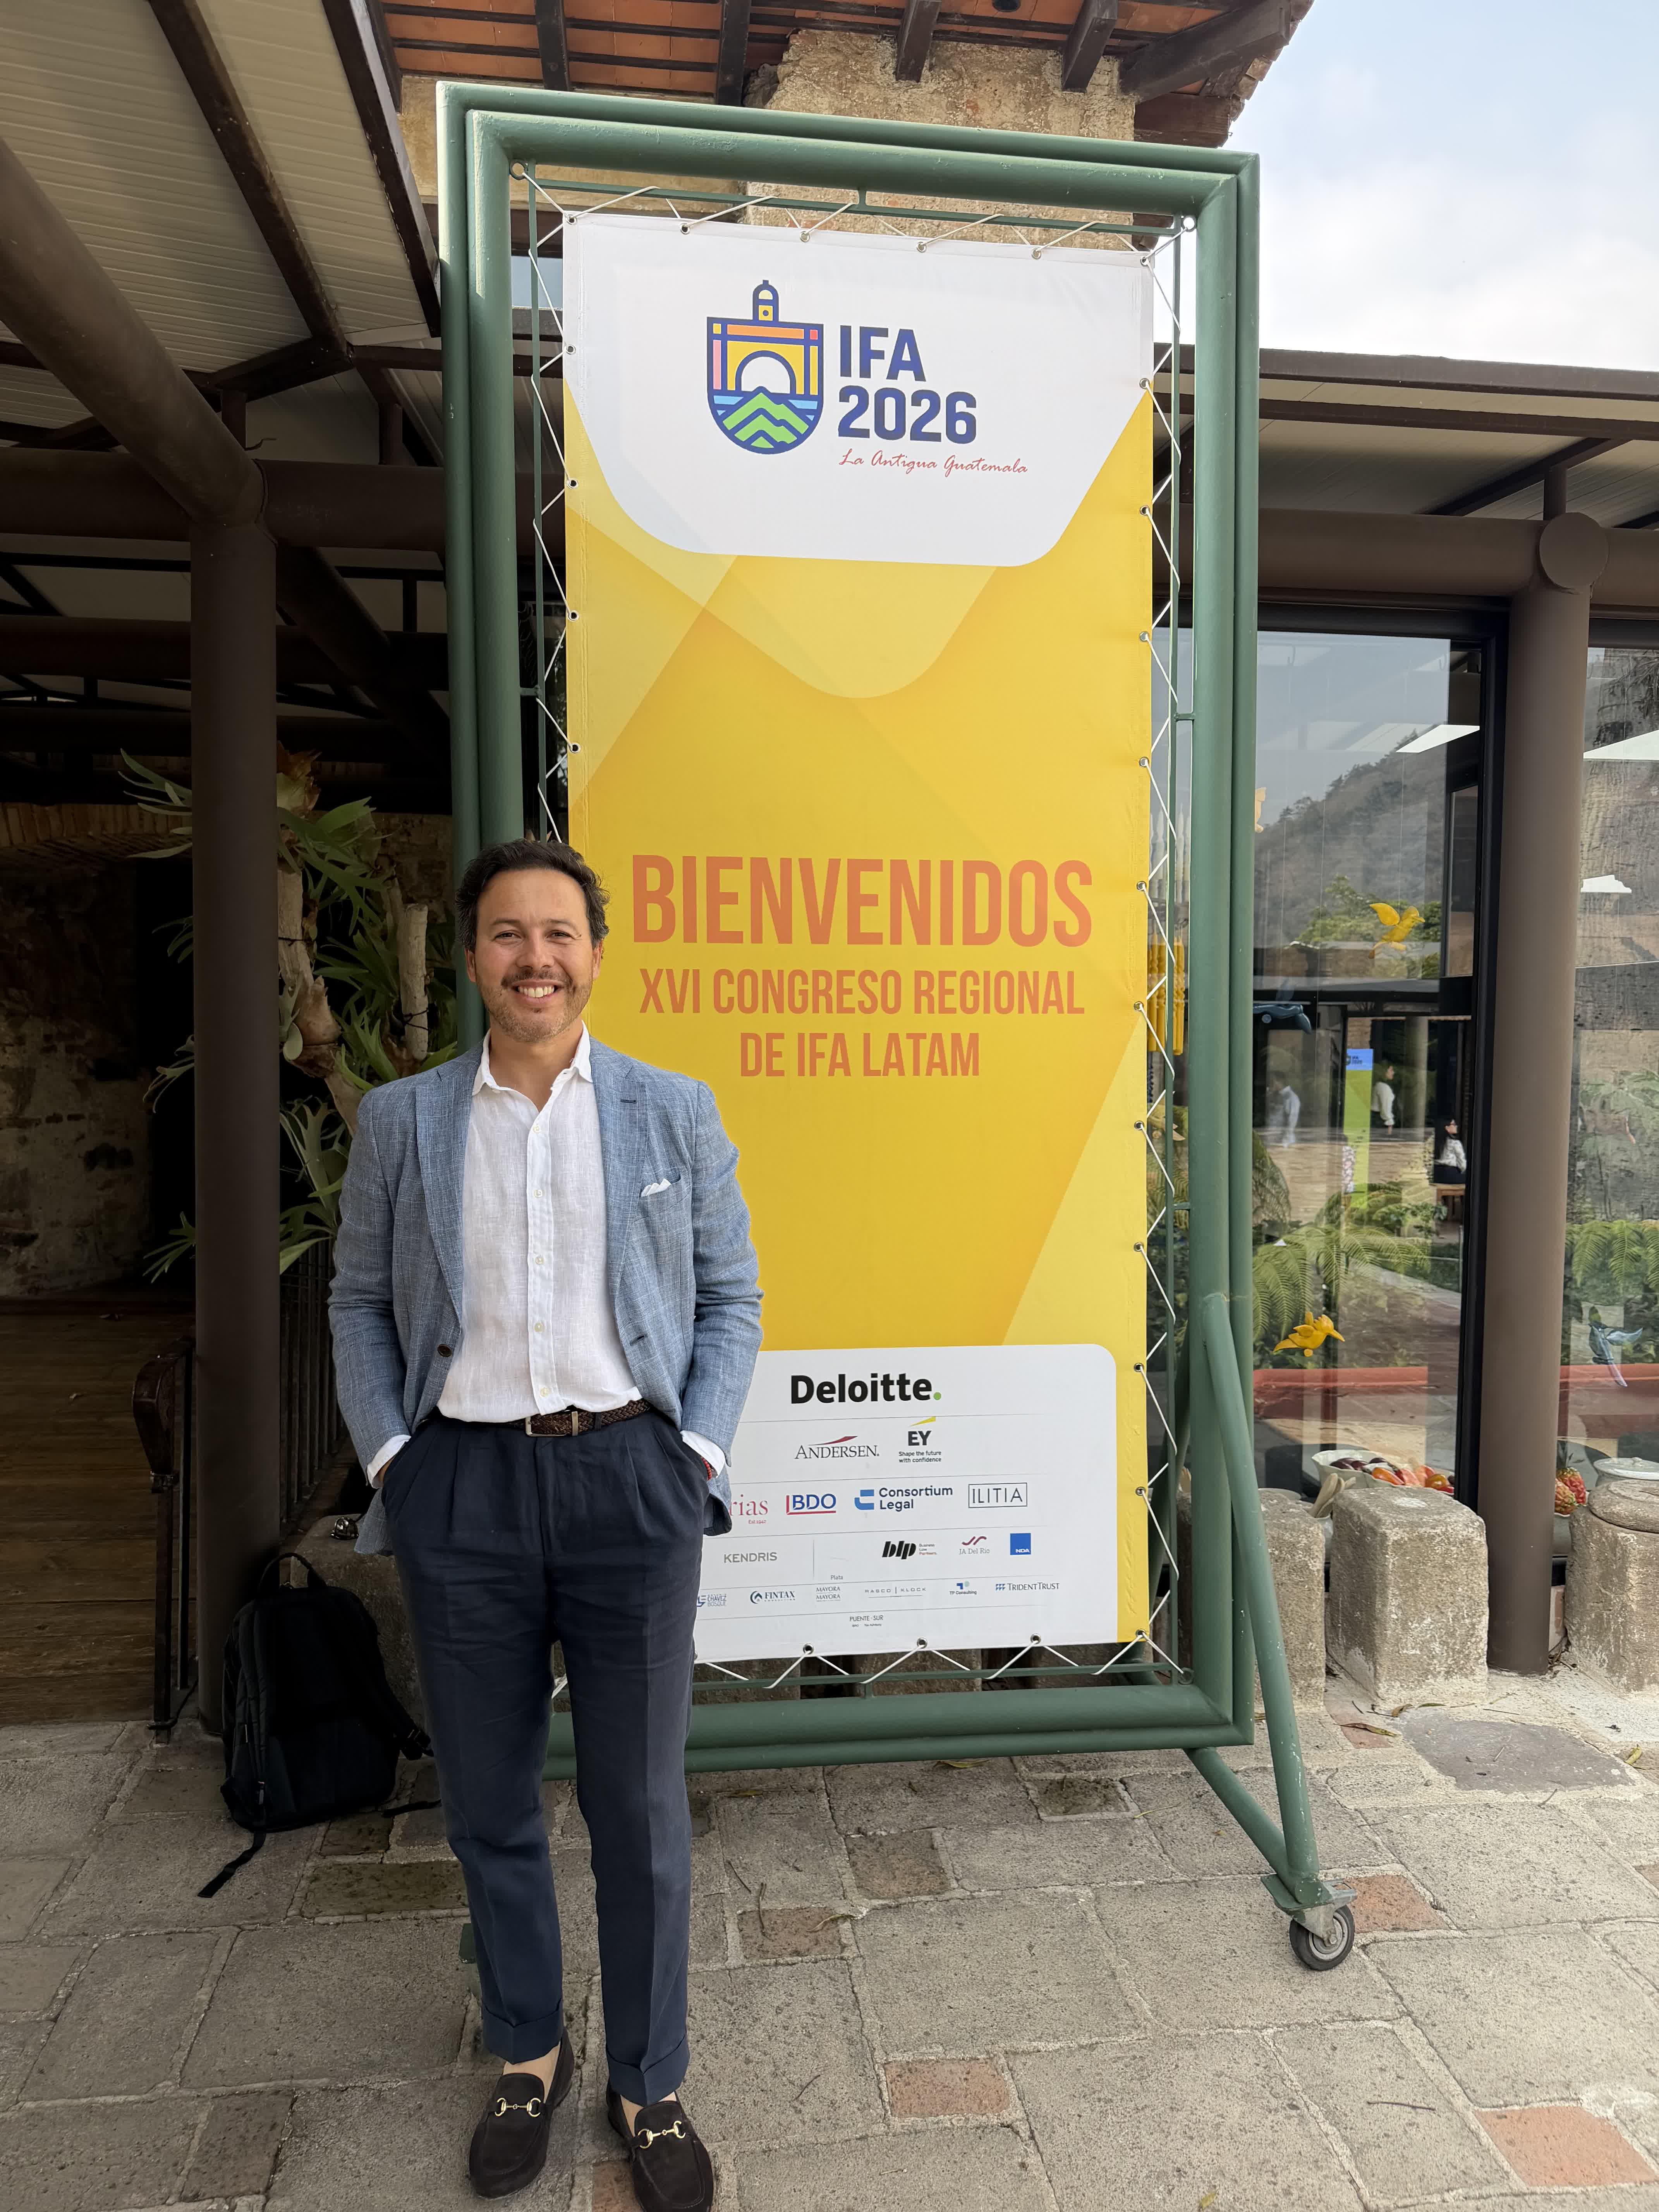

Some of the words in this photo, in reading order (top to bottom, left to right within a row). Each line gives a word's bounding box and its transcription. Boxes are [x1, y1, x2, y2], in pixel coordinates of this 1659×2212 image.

[840, 325, 926, 382] IFA
[838, 385, 976, 444] 2026
[838, 448, 864, 465] La
[871, 450, 937, 474] Antigua
[944, 455, 1027, 477] Guatemala
[633, 855, 1092, 947] BIENVENIDOS
[639, 969, 700, 1013] XVI
[713, 969, 902, 1014] CONGRESO
[915, 970, 1085, 1014] REGIONAL
[740, 1032, 785, 1077] DE
[798, 1032, 851, 1077] IFA
[863, 1032, 980, 1077] LATAM
[908, 1431, 932, 1446] EY
[879, 1486, 952, 1497] Consortium
[973, 1488, 1022, 1503] ILITIA
[730, 1493, 768, 1516] rias
[792, 1494, 836, 1510] BDO
[880, 1499, 913, 1512] Legal
[724, 1552, 777, 1563] KENDRIS
[765, 1591, 795, 1599] FINTAX
